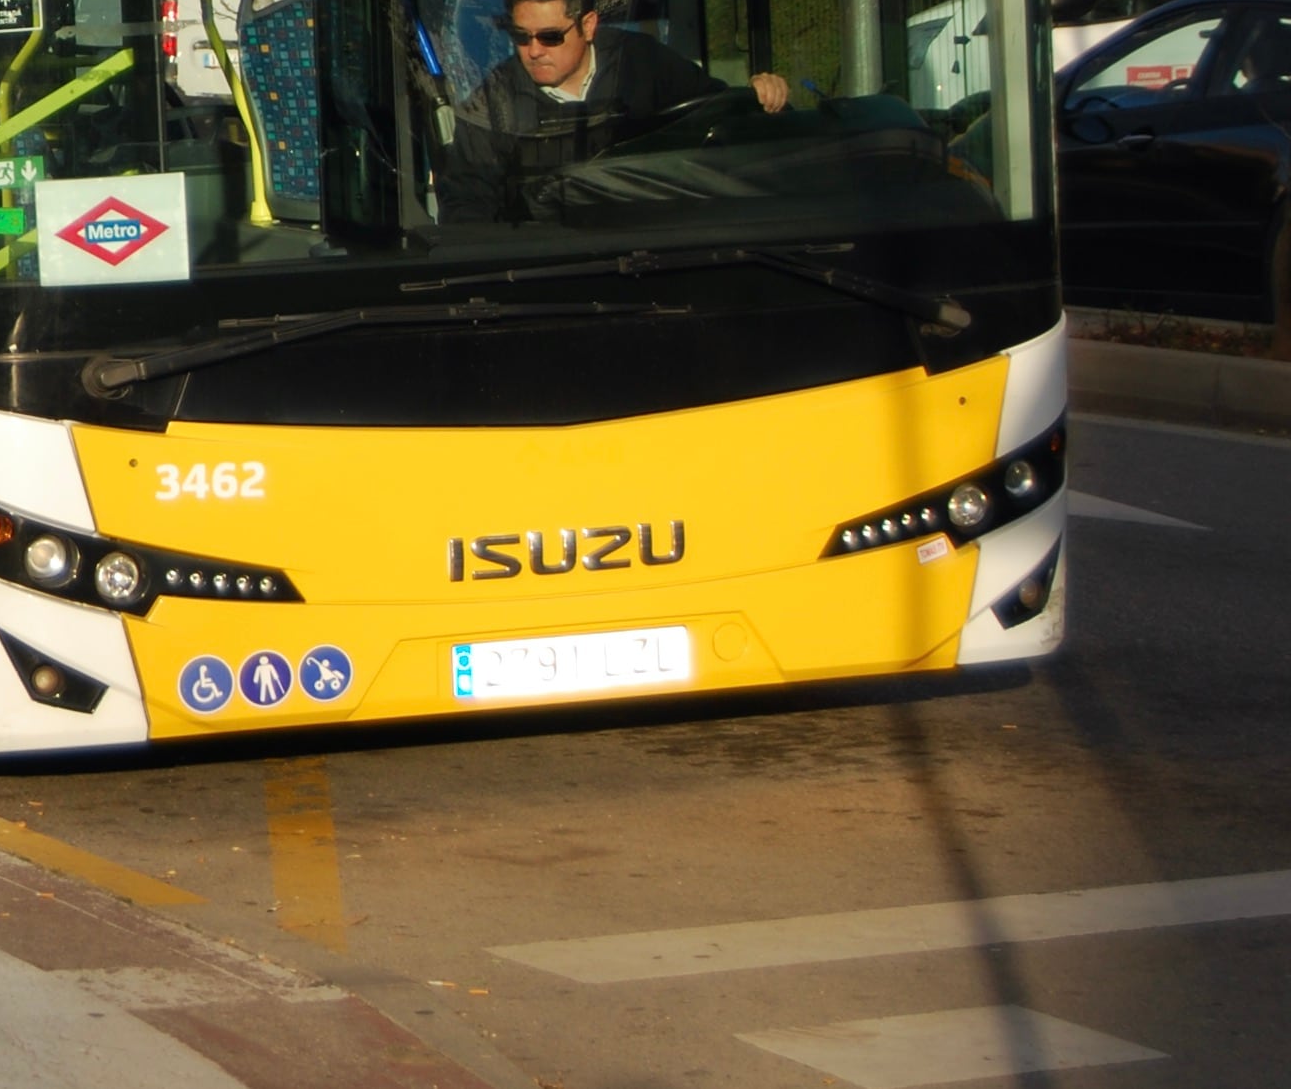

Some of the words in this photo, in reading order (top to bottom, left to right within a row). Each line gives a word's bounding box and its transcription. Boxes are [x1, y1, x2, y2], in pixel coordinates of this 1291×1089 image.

[87, 223, 138, 240] Metro
[154, 460, 266, 501] 3462
[448, 519, 686, 583] ISUZU
